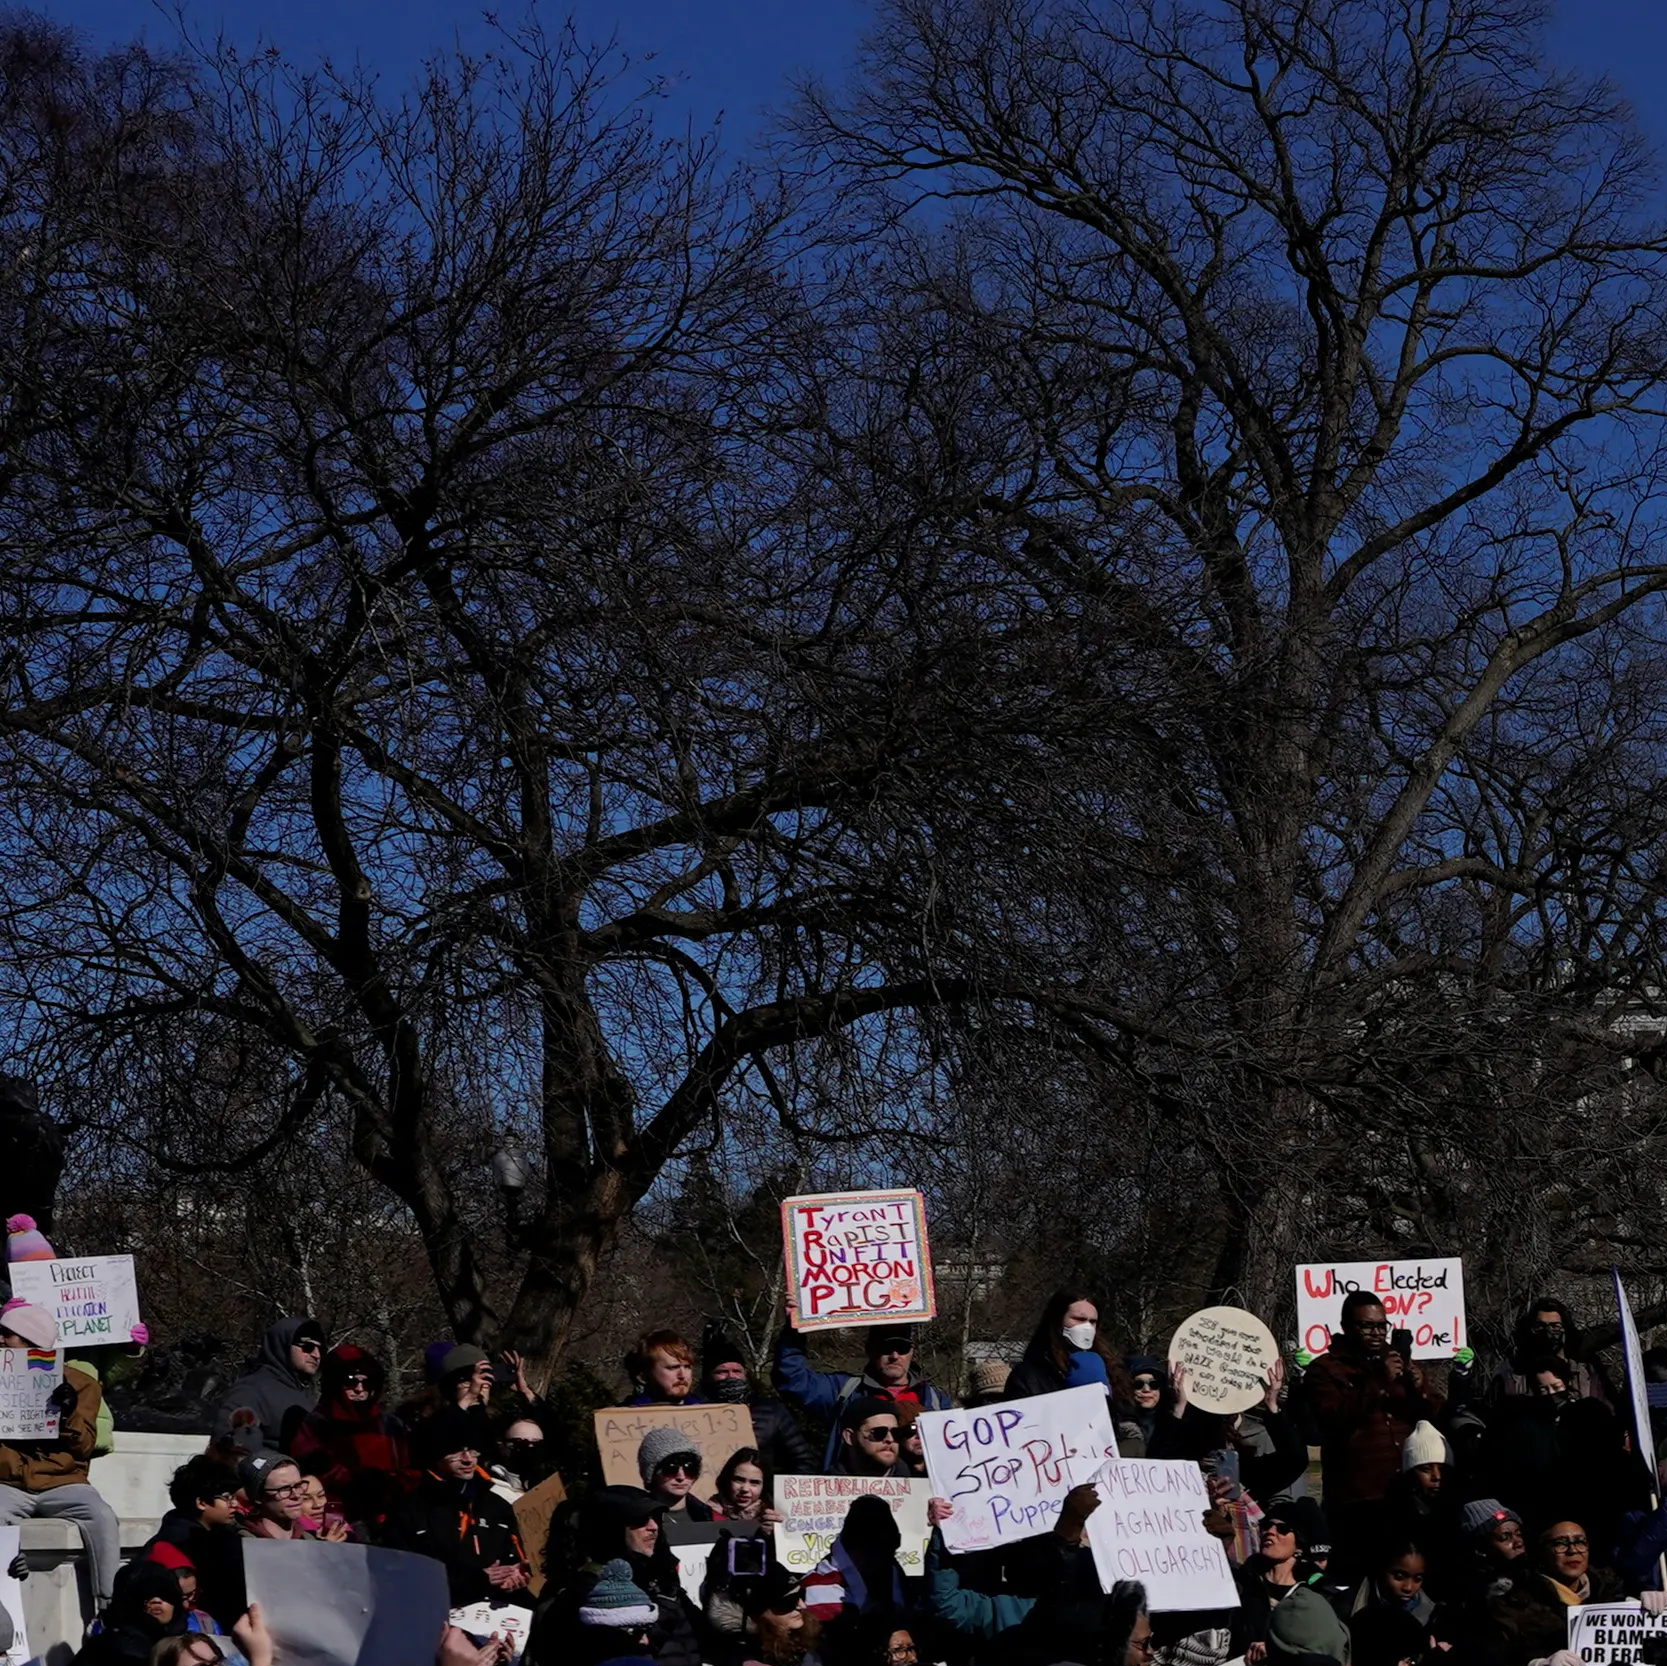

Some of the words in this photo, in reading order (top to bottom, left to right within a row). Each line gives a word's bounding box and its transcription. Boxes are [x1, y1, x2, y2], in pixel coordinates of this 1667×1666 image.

[804, 1241, 913, 1267] UNFIT
[802, 1261, 914, 1287] MORON
[1304, 1268, 1360, 1298] Who
[1374, 1265, 1447, 1292] Elected
[810, 1280, 891, 1314] PIG
[63, 1315, 113, 1335] PLANET
[33, 1374, 58, 1389] NOT
[784, 1477, 911, 1499] REPUBLICAN
[952, 1456, 1023, 1500] STOP
[987, 1487, 1068, 1535] Puppe
[1116, 1508, 1198, 1537] AGAINST
[1117, 1540, 1226, 1580] OLIGARCHY
[1586, 1615, 1607, 1626] WE
[1582, 1647, 1605, 1662] OR
